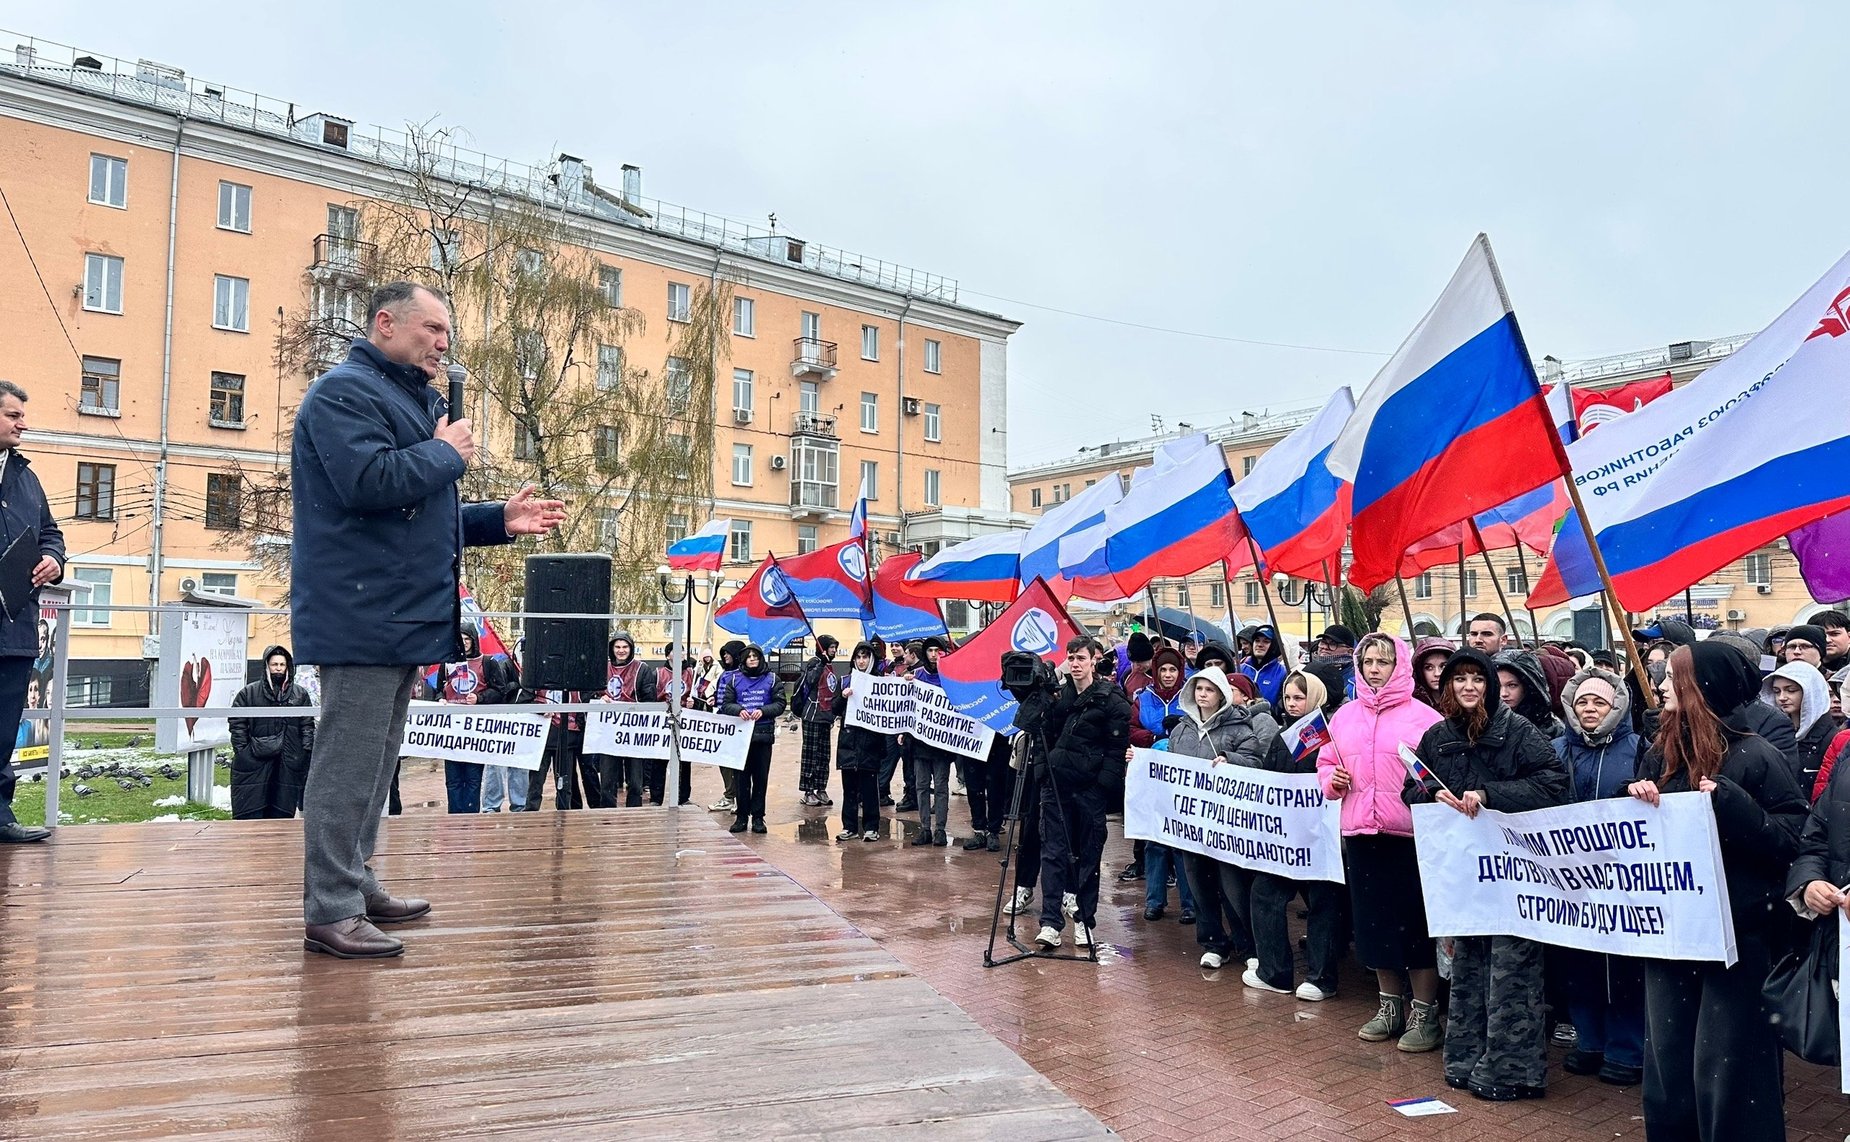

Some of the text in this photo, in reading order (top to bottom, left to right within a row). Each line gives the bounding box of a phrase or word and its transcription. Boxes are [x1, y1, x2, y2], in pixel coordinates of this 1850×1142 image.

[416, 713, 451, 729] СИЛА
[464, 716, 473, 731] В
[475, 717, 543, 738] ЕДИНСТВЕ
[652, 714, 661, 728] И
[921, 706, 976, 735] РАЗВИТИЕ
[408, 731, 516, 755] СОЛИДАРНОСТИ!
[615, 731, 722, 754] ЗА МИР И ОБЕДУ
[917, 722, 984, 754] ЭКОНОМИКИ!
[1149, 761, 1328, 809] ВМЕСТЕ МЫ СОЗДАЕМ СТРАНУ,
[1174, 793, 1288, 838] ГДЕ ТРУД ЦЕНИТСЯ,
[1163, 816, 1311, 867] А ПРАВА СОБЛЮДАЮТСЯ!
[1549, 819, 1657, 856] ПРОШЛОЕ,
[1558, 867, 1582, 891] В
[1575, 860, 1704, 895] НАСТОЯЩЕМ,
[1516, 893, 1665, 937] СТРОИМ БУДУЩЕЕ!
